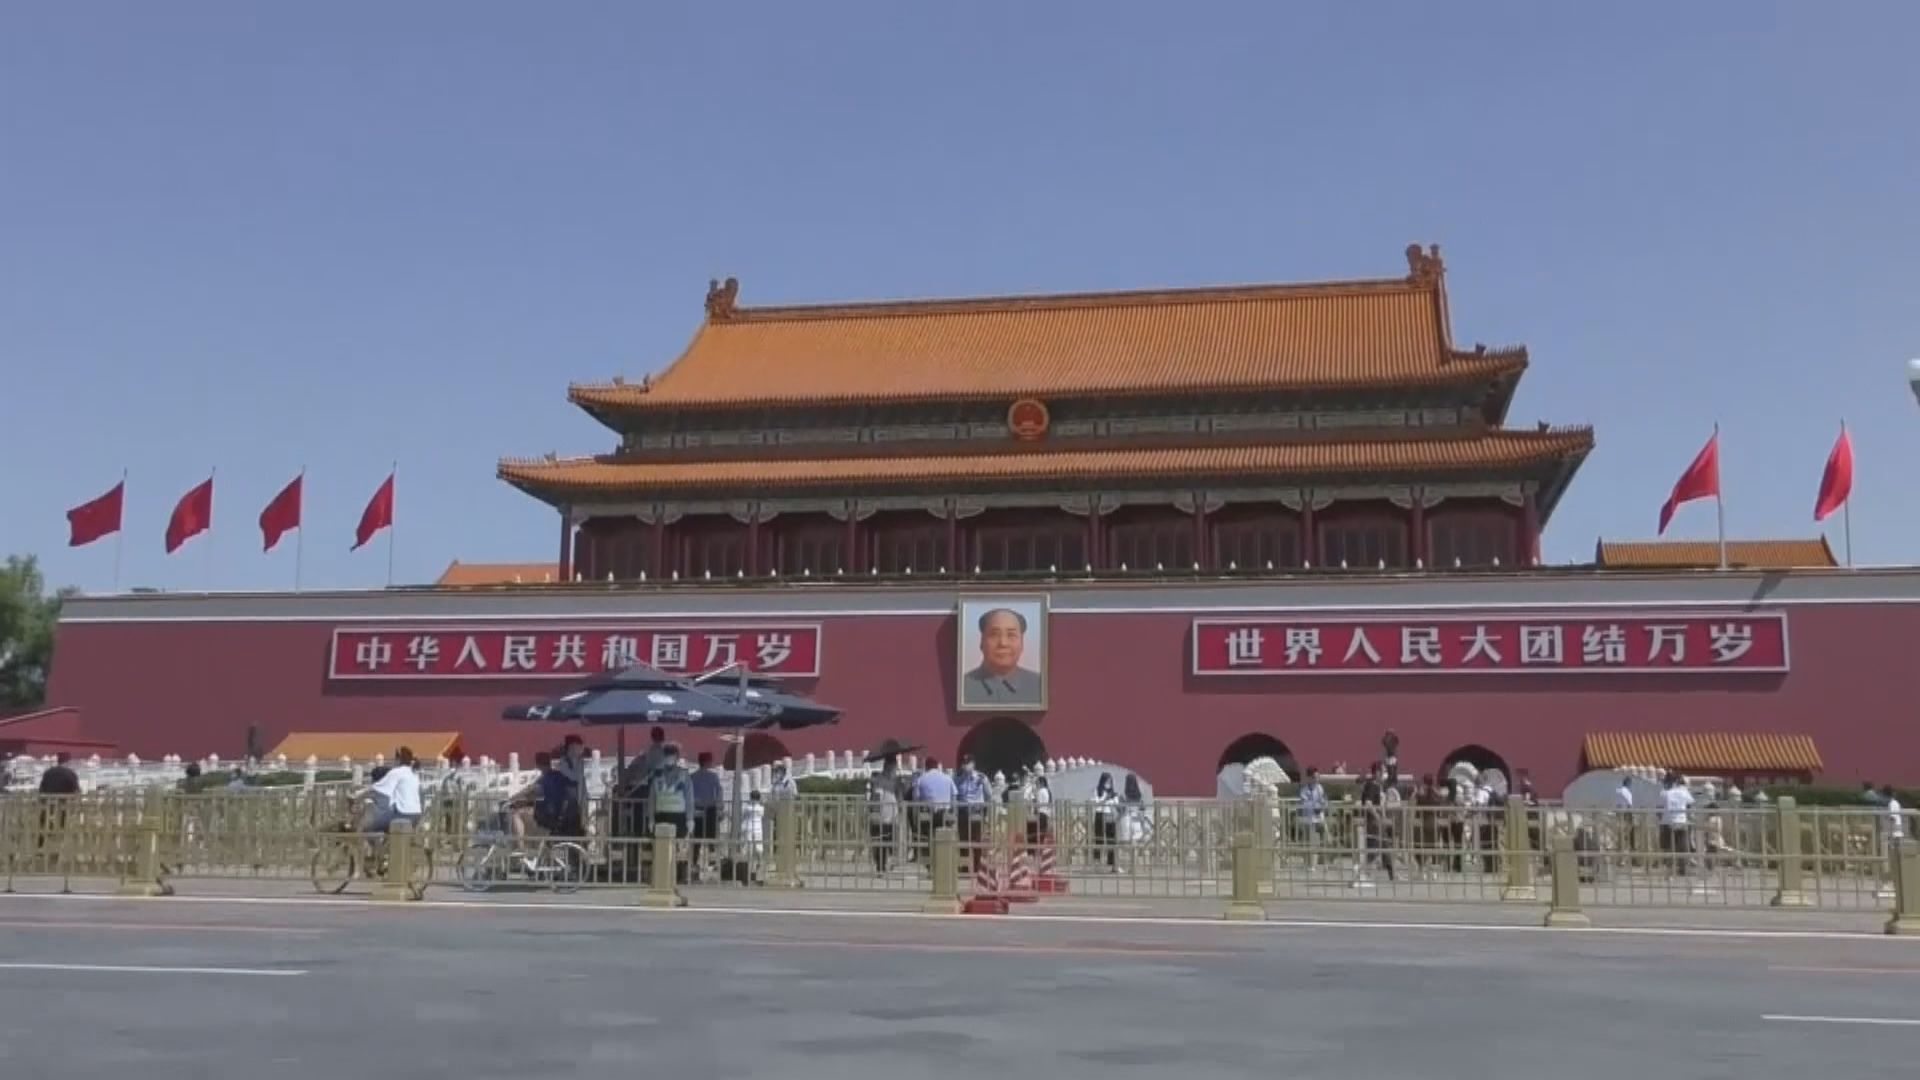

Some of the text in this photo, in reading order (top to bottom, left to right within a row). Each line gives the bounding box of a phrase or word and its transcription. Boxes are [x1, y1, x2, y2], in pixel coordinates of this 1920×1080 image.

[357, 633, 792, 670] 中华人民共和国万岁
[1225, 624, 1753, 665] 世界人民大团结万岁
